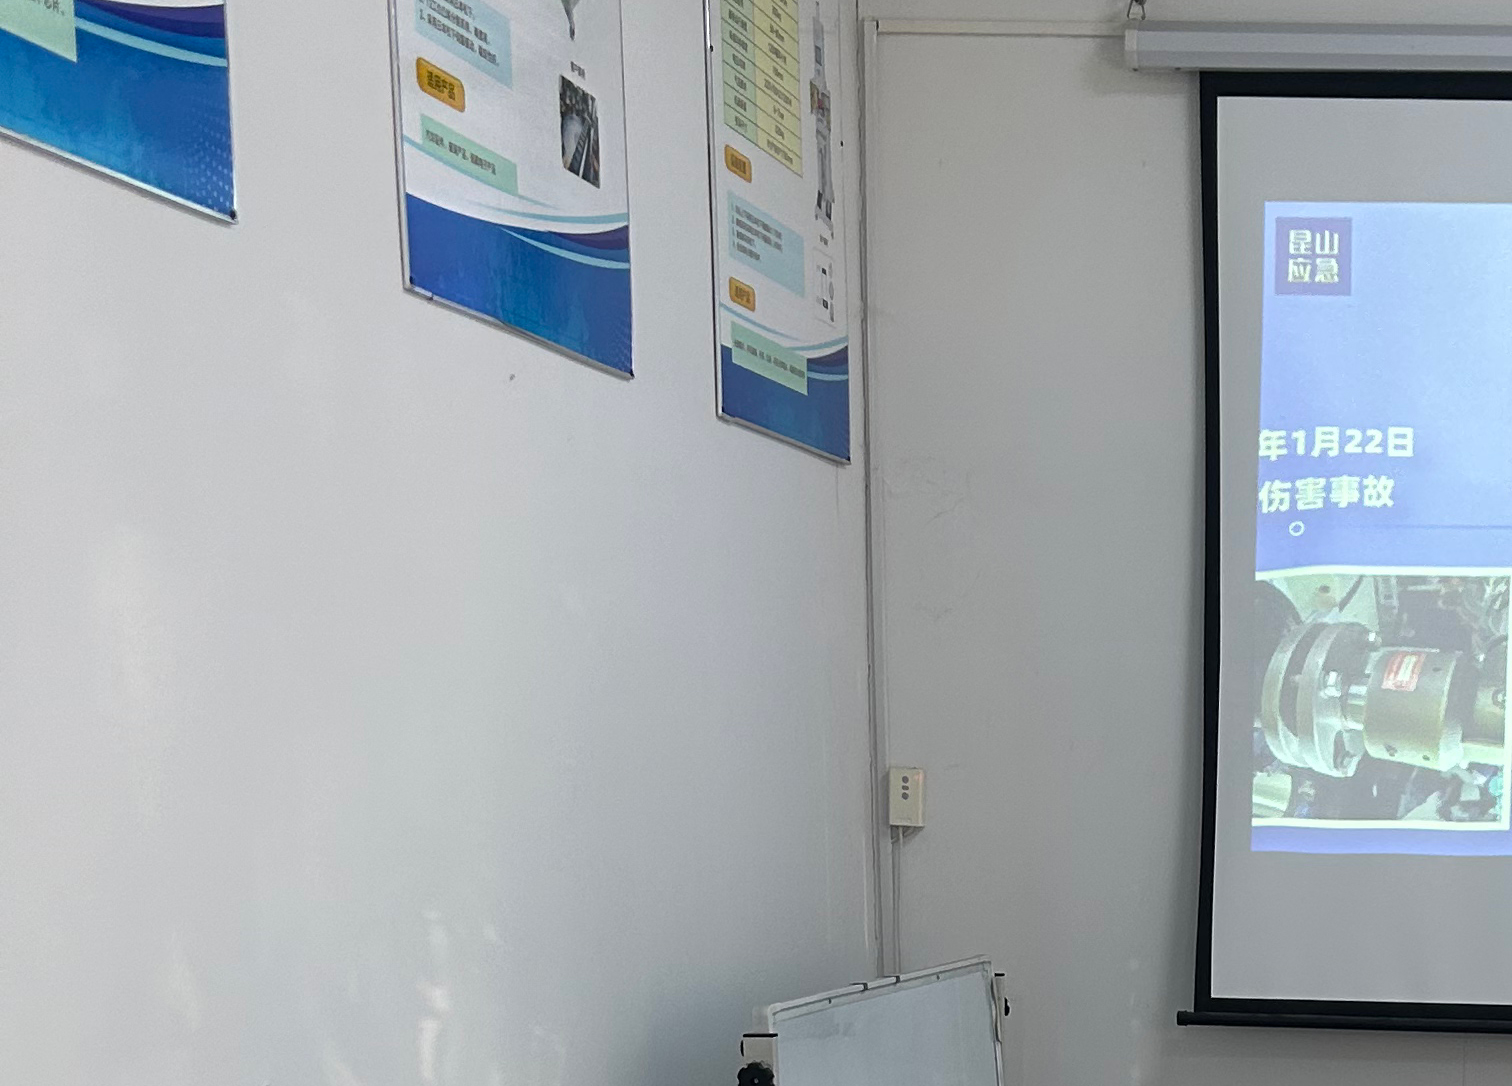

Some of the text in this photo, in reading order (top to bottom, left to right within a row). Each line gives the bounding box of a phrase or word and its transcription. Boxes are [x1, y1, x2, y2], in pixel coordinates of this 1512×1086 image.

[1288, 229, 1340, 256] 昆山
[1287, 257, 1340, 284] 应急
[1258, 426, 1415, 461] 年1月22日
[1259, 475, 1396, 514] 伤害事故
